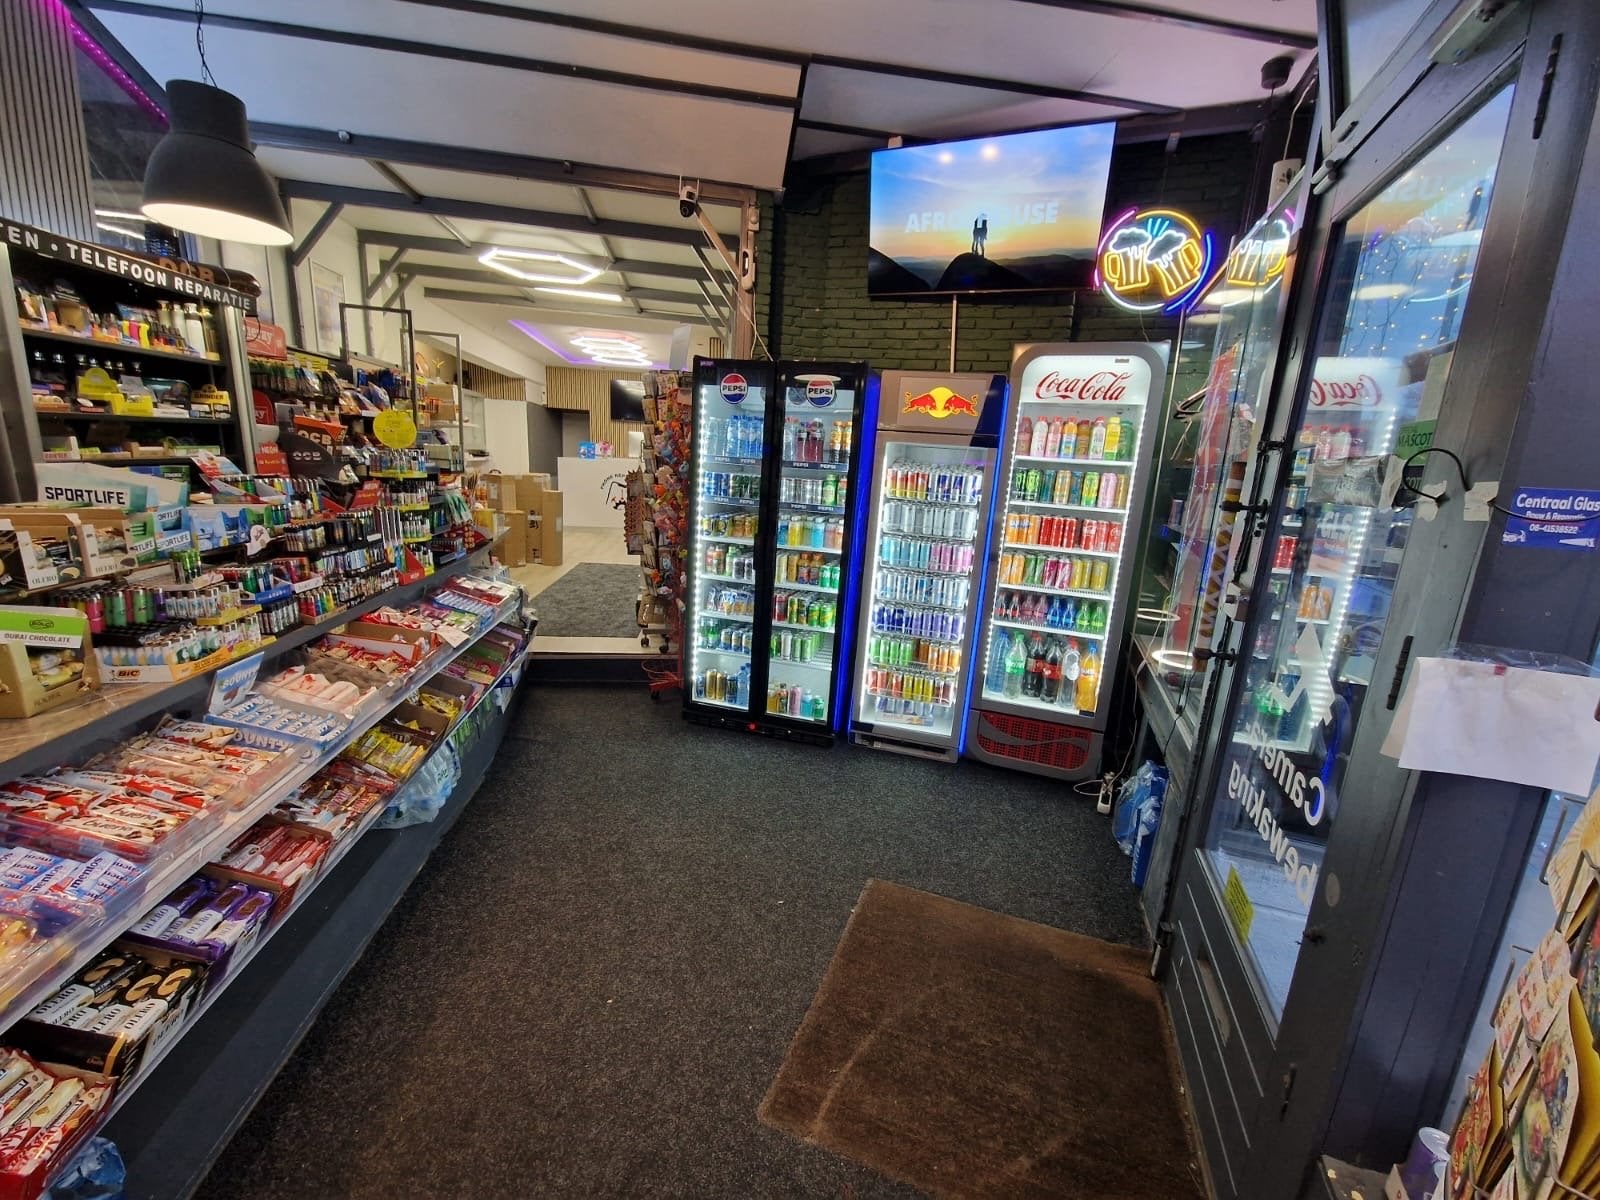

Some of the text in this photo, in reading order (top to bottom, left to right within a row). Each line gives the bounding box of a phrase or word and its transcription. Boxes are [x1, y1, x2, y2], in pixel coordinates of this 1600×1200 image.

[0, 222, 252, 310] EN TELEFOON REPARATIE
[722, 384, 746, 393] PEPSI
[808, 387, 834, 396] PEPSI
[45, 486, 126, 505] SPORTLIFE
[1516, 493, 1574, 510] Centraal
[28, 634, 71, 643] CHOCOLATE
[234, 729, 291, 751] OUNTY
[110, 806, 158, 820] bueno
[82, 818, 134, 833] bueno
[30, 865, 64, 893] mentos
[71, 856, 104, 889] mentos
[35, 985, 78, 1015] OLERO
[124, 1001, 156, 1030] OLERO
